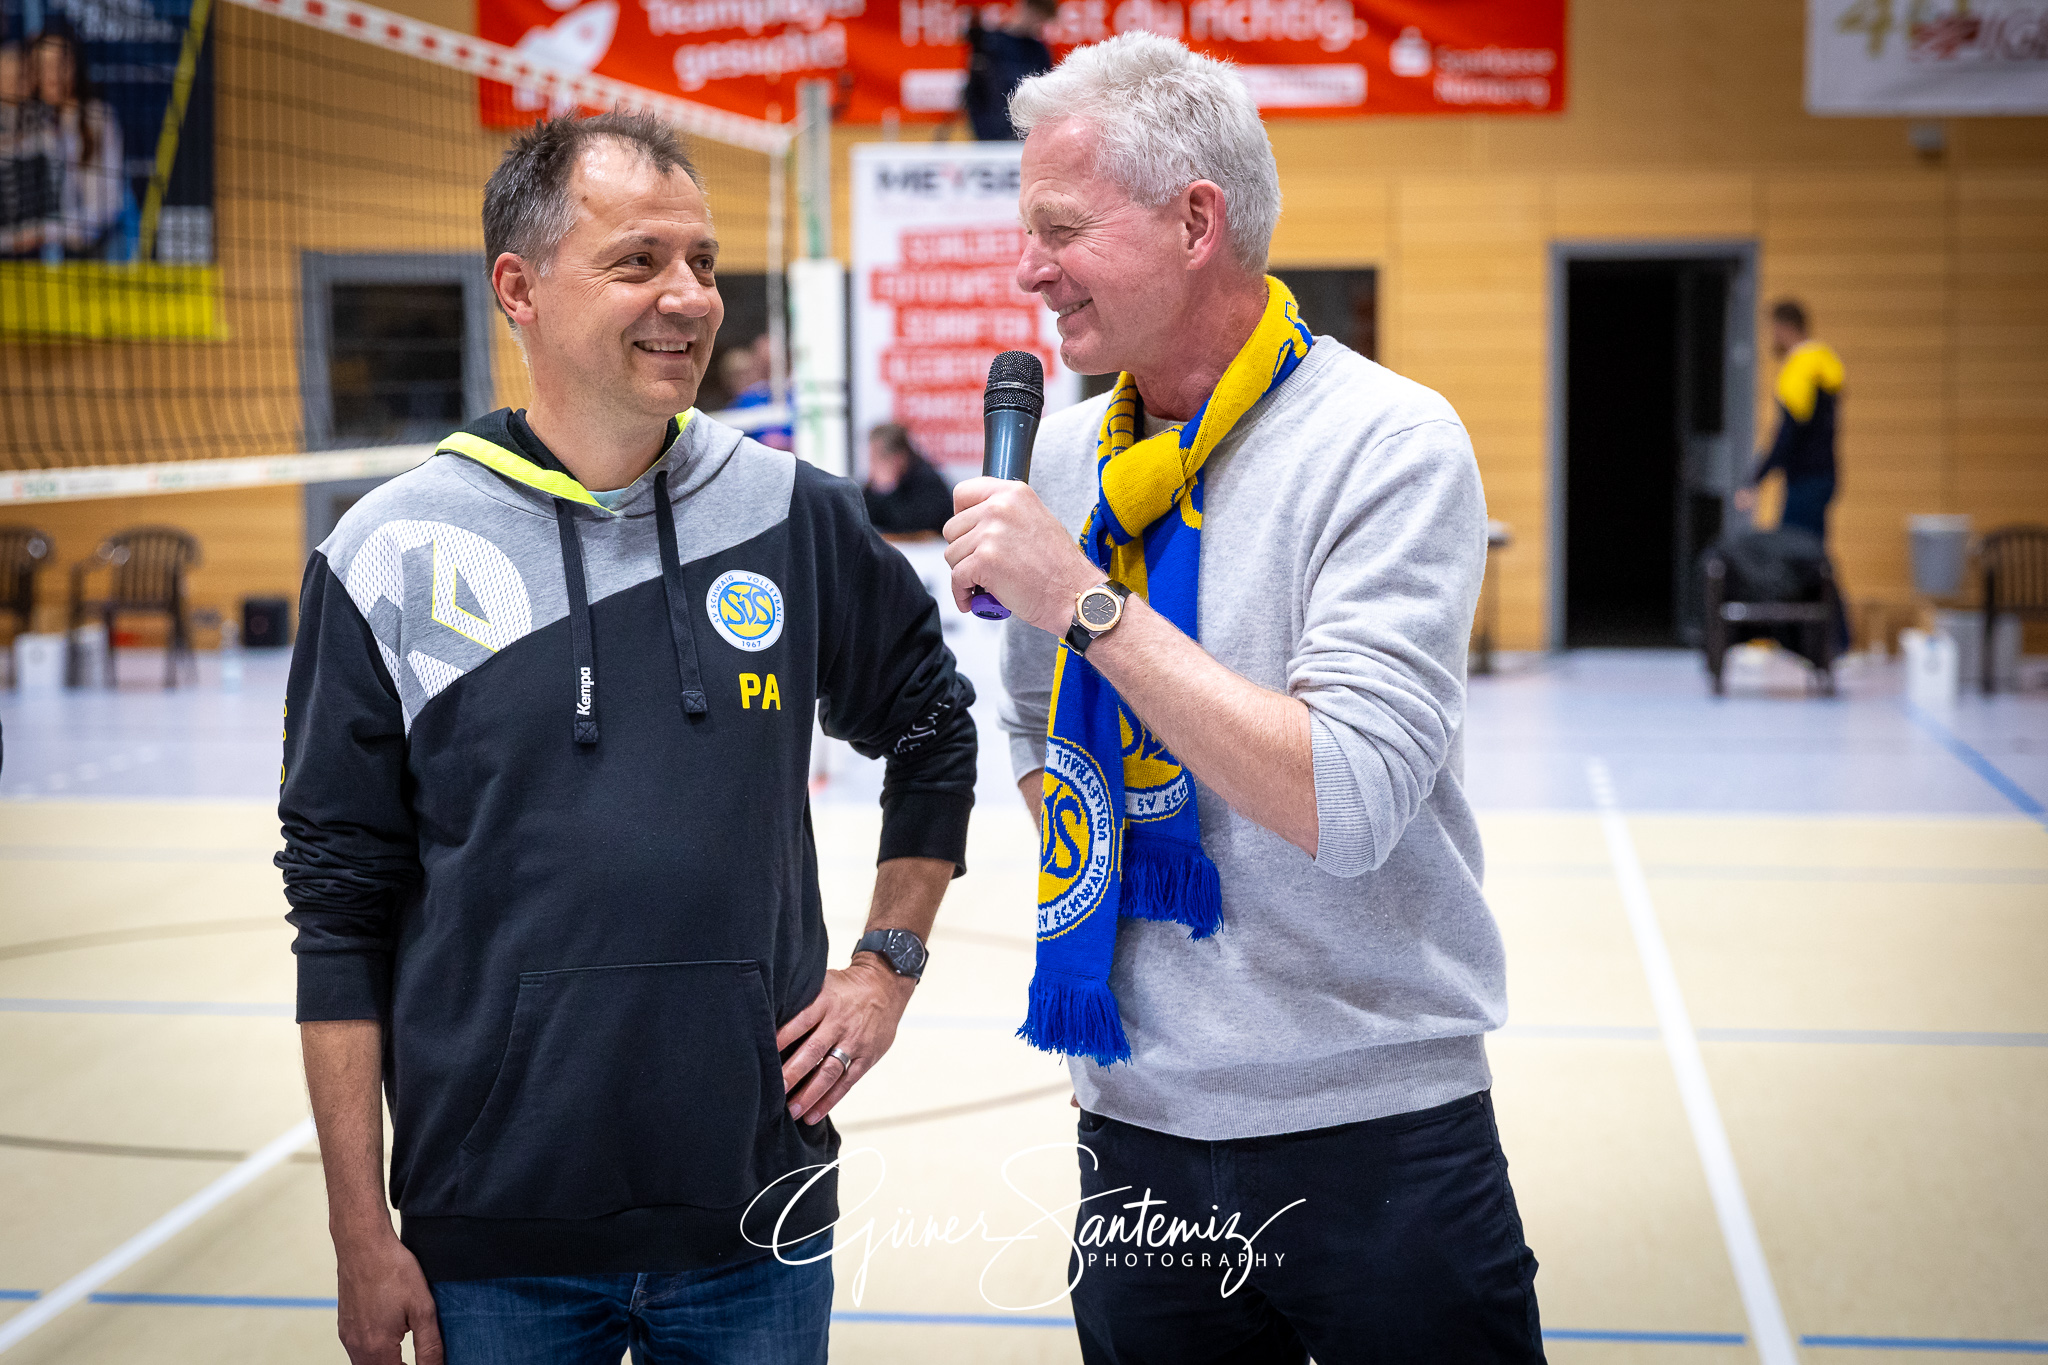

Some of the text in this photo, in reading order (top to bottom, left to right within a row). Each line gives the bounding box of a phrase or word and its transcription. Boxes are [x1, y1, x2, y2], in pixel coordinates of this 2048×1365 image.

[710, 575, 782, 623] SV SCHWAIG VOLLEYBALL
[741, 640, 762, 648] 1967
[577, 667, 595, 715] Kempa
[739, 673, 781, 710] PA
[1056, 749, 1107, 841] VOLLEYBALL
[1137, 796, 1156, 812] SV
[1054, 856, 1105, 927] SCHWAIG
